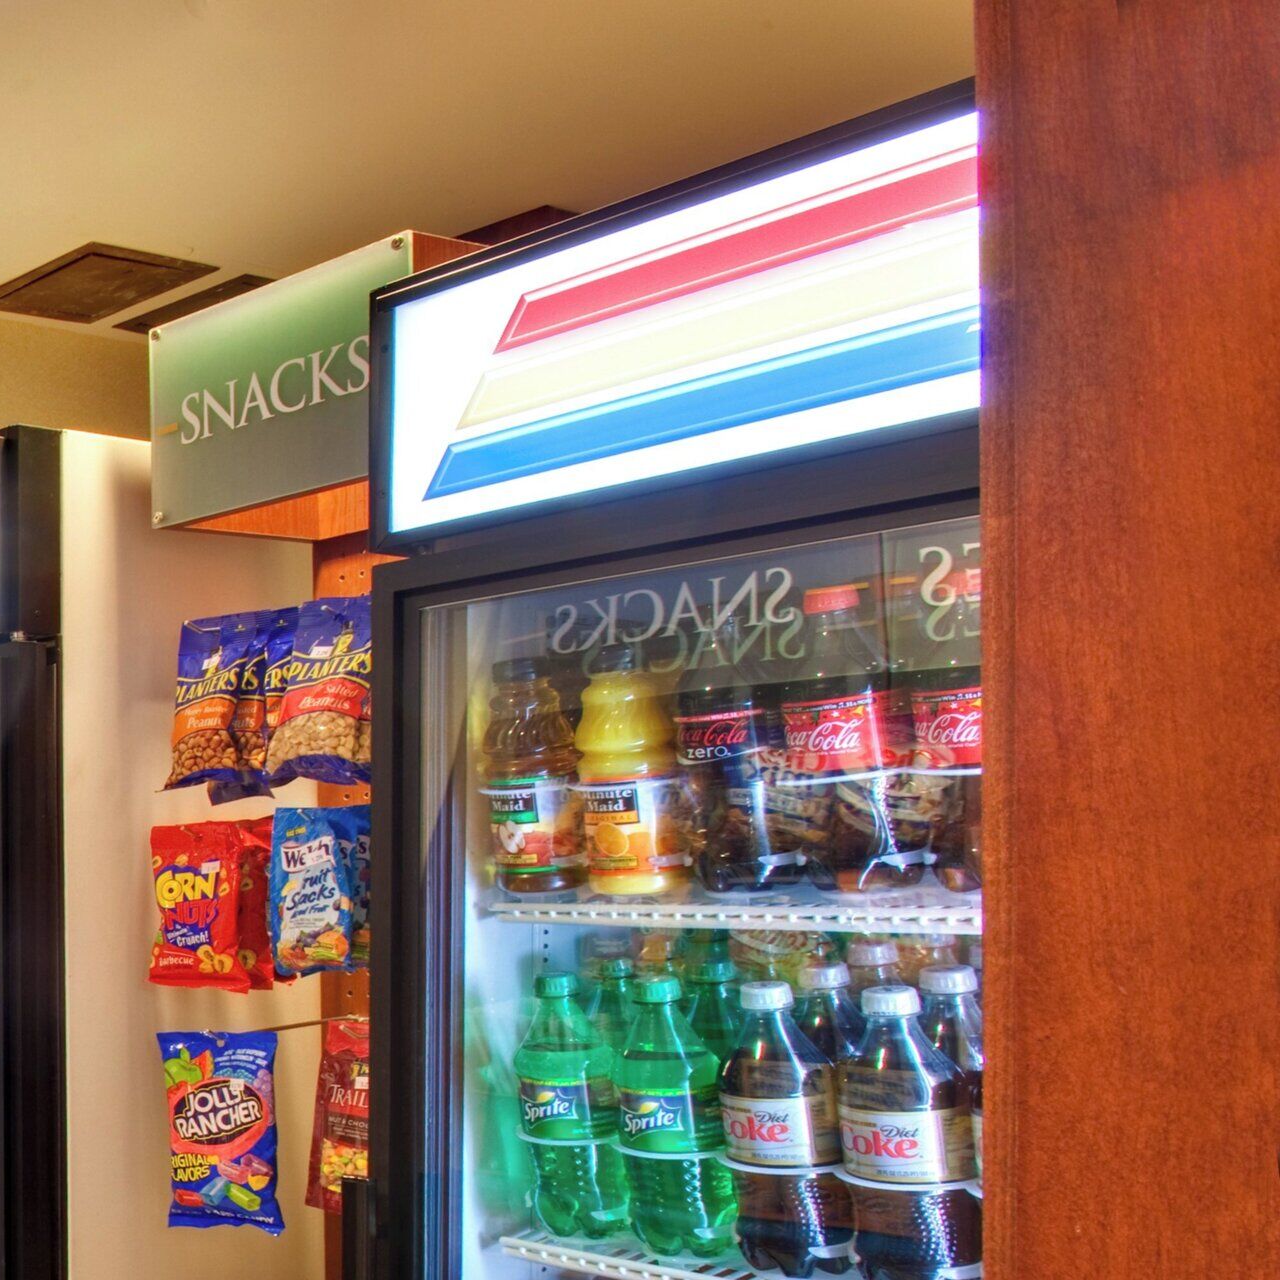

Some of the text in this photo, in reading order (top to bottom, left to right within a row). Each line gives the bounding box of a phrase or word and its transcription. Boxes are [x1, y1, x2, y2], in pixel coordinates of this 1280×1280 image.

[180, 334, 370, 445] SNACKS
[290, 650, 371, 682] PLANTERS
[324, 684, 359, 698] Salted
[187, 715, 222, 729] Peanut
[686, 743, 729, 761] zero
[492, 799, 527, 812] Maid
[588, 798, 627, 812] Maid
[156, 870, 216, 909] CORN
[302, 868, 332, 890] ruit
[165, 899, 217, 931] NUTS
[176, 930, 210, 947] Crunch!
[328, 1084, 370, 1108] TRAIL
[175, 1100, 262, 1139] RANCHER
[524, 1100, 570, 1123] Sprite
[624, 1109, 675, 1135] Sprite
[755, 1110, 790, 1124] Diet
[722, 1110, 790, 1143] Coke
[880, 1124, 919, 1139] Diet
[841, 1122, 919, 1160] Coke
[171, 1153, 213, 1168] RIGINAL
[171, 1166, 212, 1183] LAVORS
